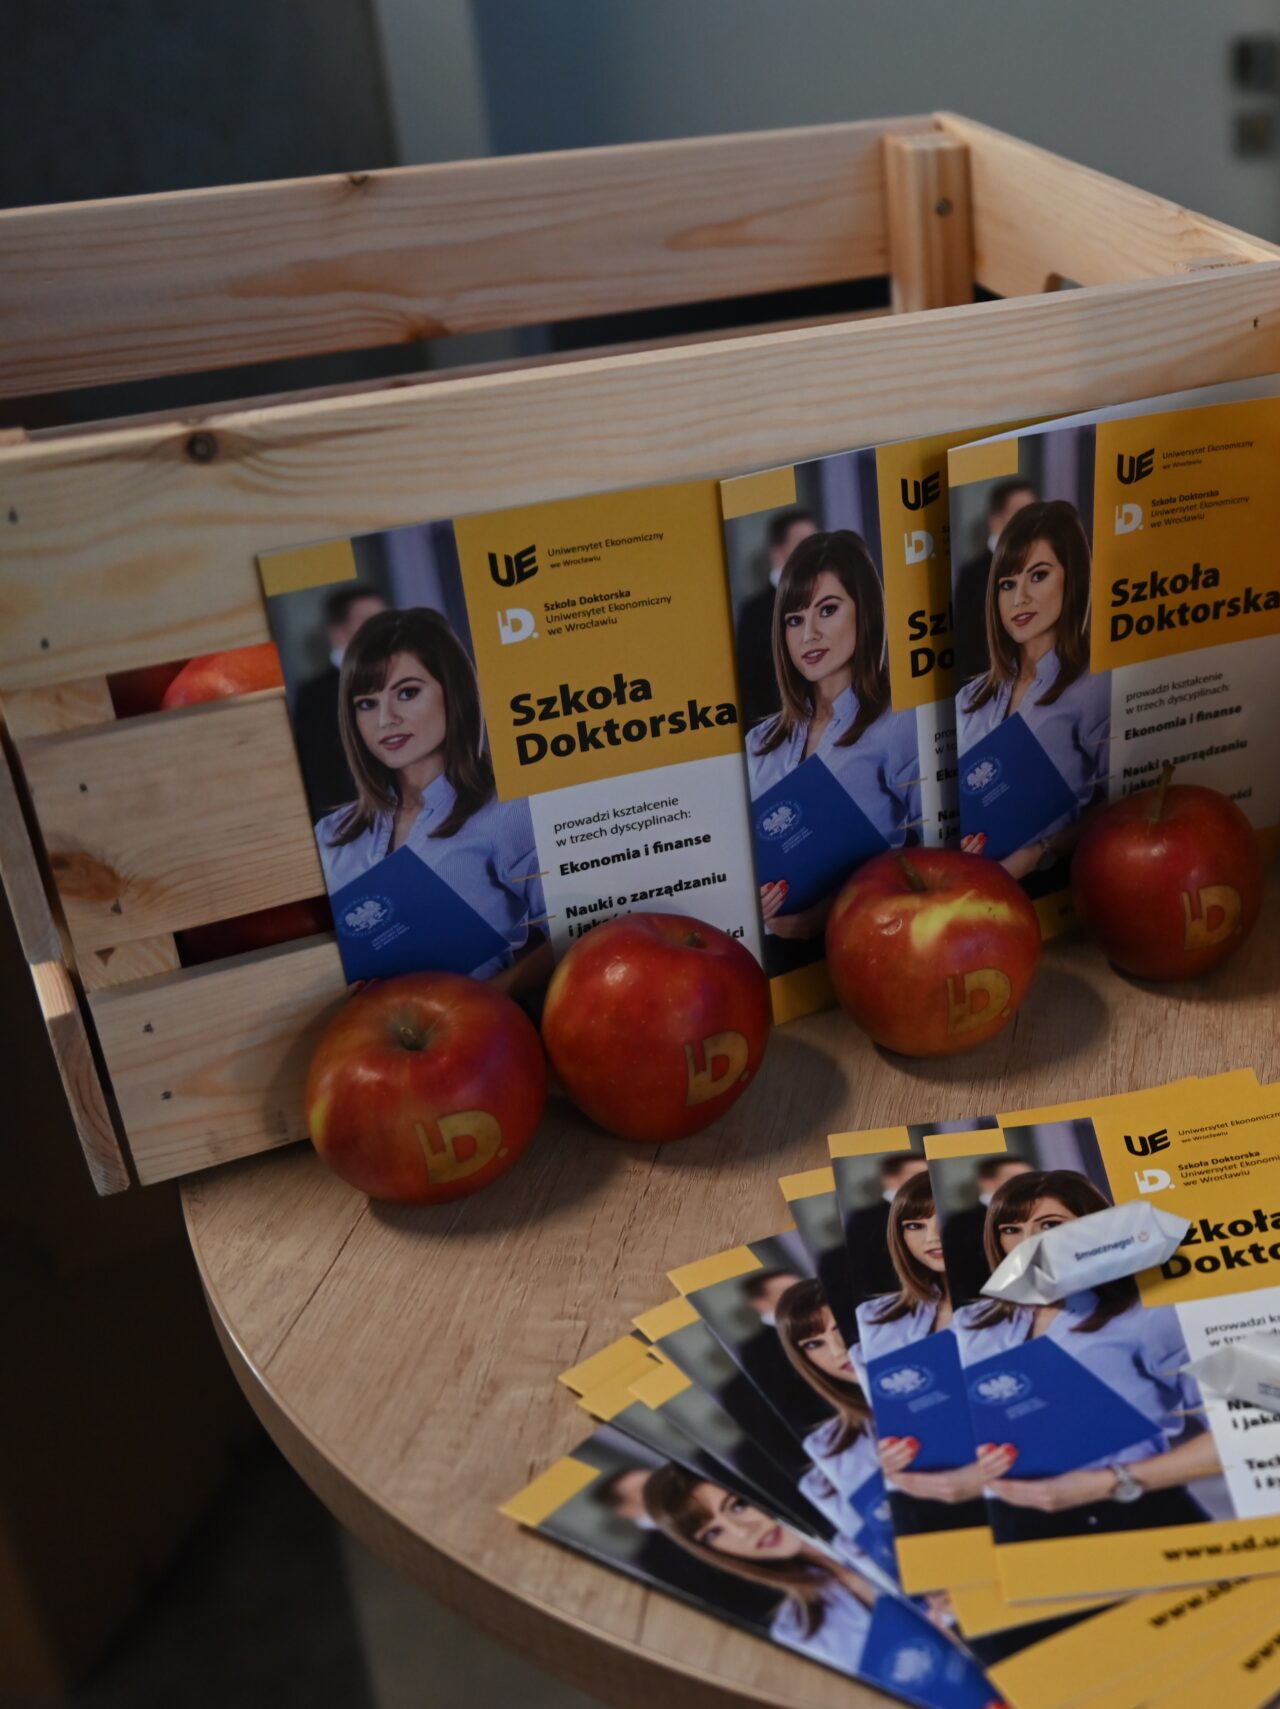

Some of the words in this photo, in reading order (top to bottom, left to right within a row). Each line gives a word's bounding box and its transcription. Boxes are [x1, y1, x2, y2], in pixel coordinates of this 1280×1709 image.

[1163, 447, 1205, 460] Uniwersytet
[1208, 440, 1253, 453] Ekonomiczny
[1117, 448, 1155, 484] UE
[901, 471, 940, 511] UE
[1152, 497, 1176, 507] Szkoła
[1179, 489, 1219, 502] Doktorska
[1151, 504, 1198, 518] Uniwersytet
[1200, 496, 1249, 510] Ekonomiczny
[548, 540, 603, 557] Uniwersytet
[605, 532, 664, 548] Ekonomiczny
[488, 544, 539, 587] UE
[550, 561, 561, 569] we
[563, 554, 601, 567] Wrocławiu
[1110, 562, 1220, 607] Szkoła
[544, 598, 577, 612] Szkoła
[579, 589, 631, 605] Doktorska
[546, 605, 606, 623] Uniwersytet
[608, 595, 672, 613] Ekonomiczny
[1109, 586, 1280, 642] Doktorska
[547, 627, 562, 636] we
[565, 615, 617, 632] Wrocławiu
[510, 673, 652, 726] Szkoła
[1126, 683, 1169, 703] prowadzi
[1172, 672, 1223, 690] kształcenie
[1137, 698, 1165, 712] trzech
[1167, 683, 1230, 705] dyscyplinach:
[516, 699, 737, 766] Doktorska
[1124, 717, 1186, 740] Ekonomia
[1196, 705, 1242, 722] finanse
[1123, 760, 1159, 778] Nauki
[1173, 739, 1247, 765] zarządzaniu
[553, 810, 610, 834] prowadzi
[613, 797, 679, 819] kształcenie
[556, 838, 567, 847] w
[570, 828, 607, 844] trzech
[610, 809, 692, 837] dyscyplinach:
[559, 848, 640, 876] Ekonomia
[653, 832, 711, 853] finanse
[566, 896, 613, 919] Nauki
[617, 896, 627, 905] o
[630, 872, 727, 903] zarządzaniu
[1124, 1129, 1171, 1156] UE
[1178, 1121, 1228, 1136] Uniwersytet
[1178, 1160, 1209, 1171] Szkoła
[1211, 1151, 1260, 1165] Doktorska
[1180, 1162, 1238, 1179] Uniwersytet
[1200, 1170, 1250, 1185] Wrocławiu
[1204, 1317, 1266, 1335] prowadzi
[1255, 1476, 1261, 1488] i
